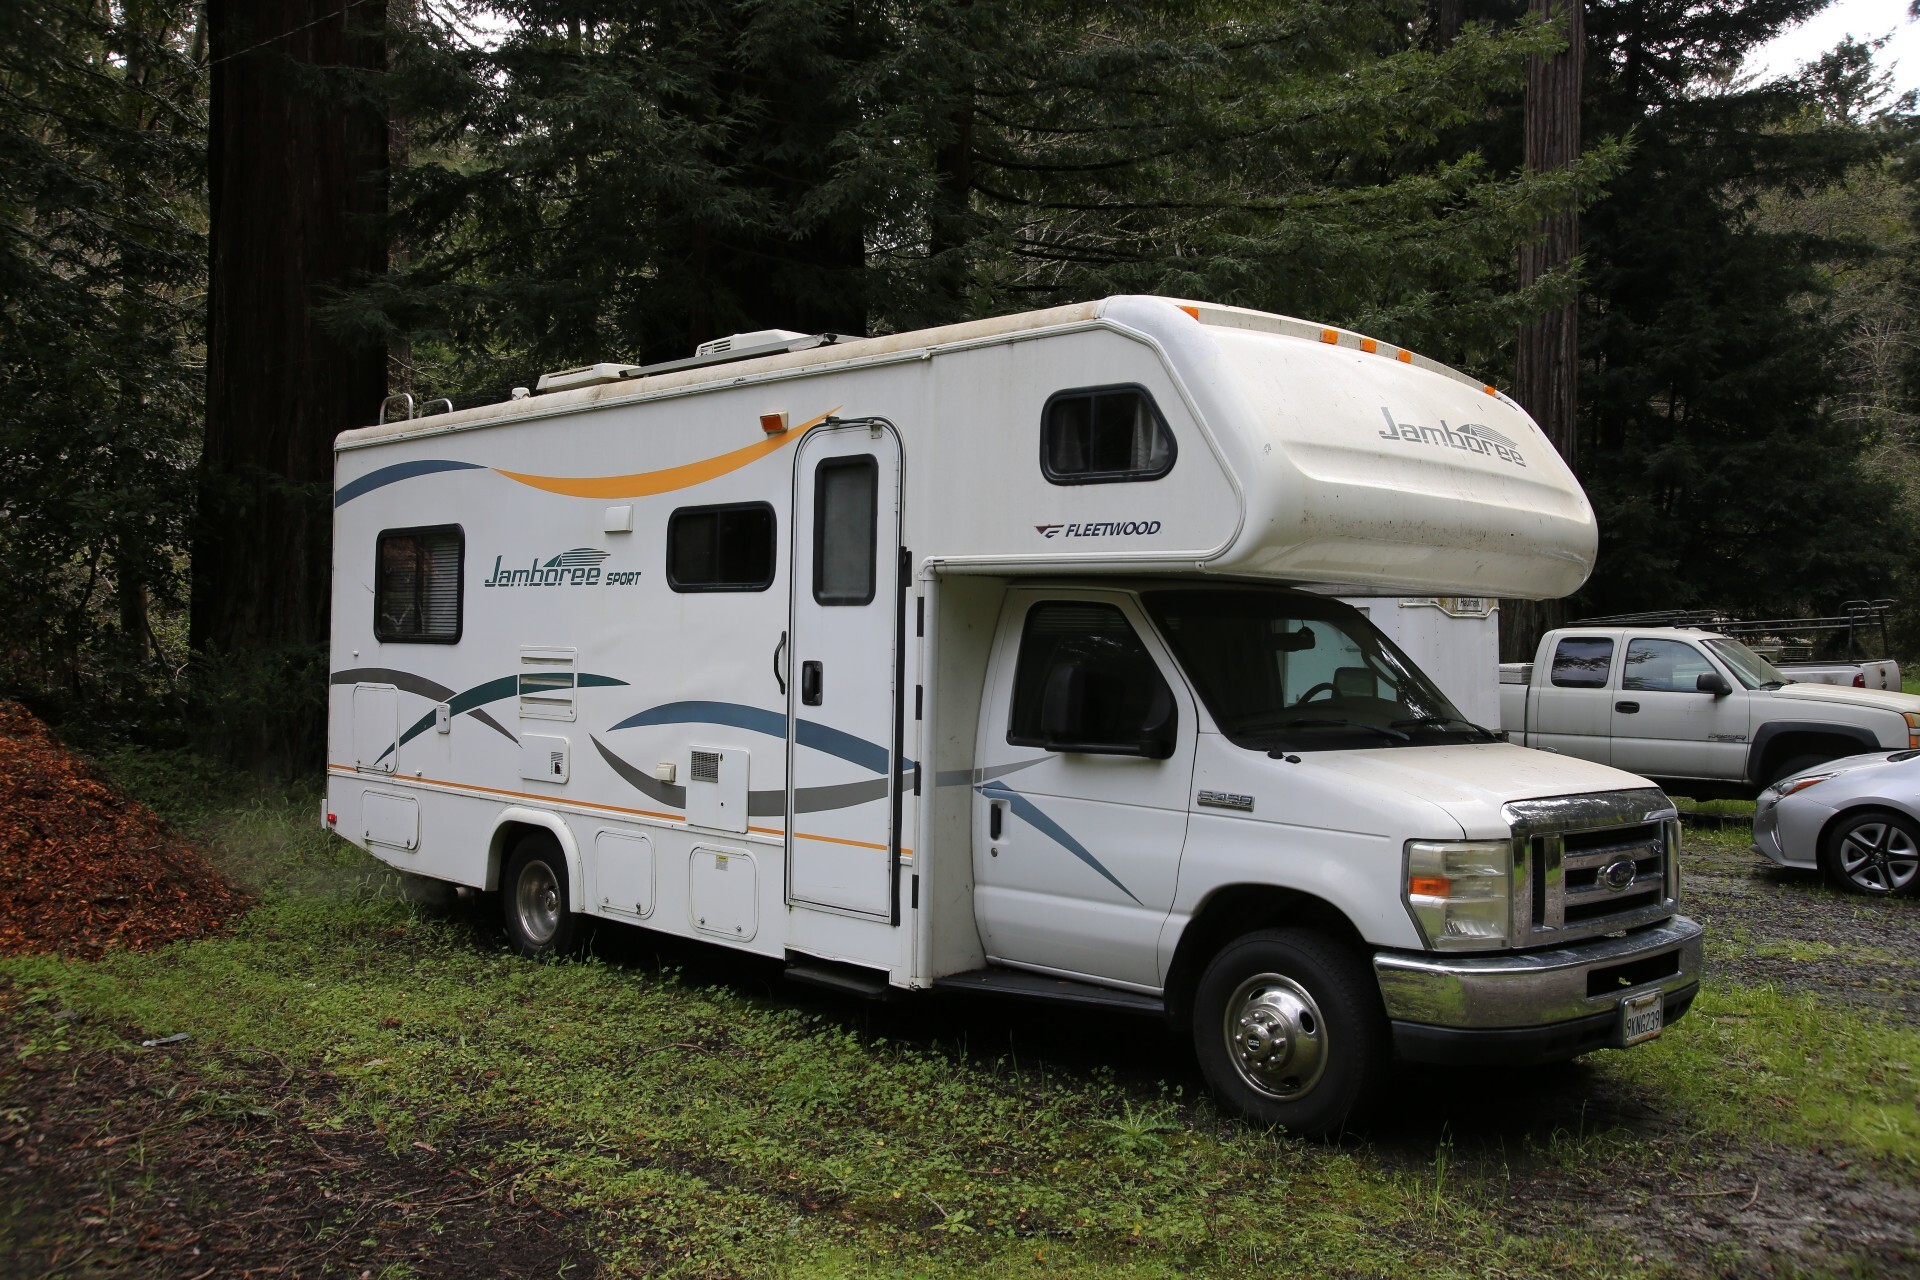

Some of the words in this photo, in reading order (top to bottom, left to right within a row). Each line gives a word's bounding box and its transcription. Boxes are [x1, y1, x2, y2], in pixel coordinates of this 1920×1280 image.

[1378, 407, 1527, 467] Jamboree
[1065, 520, 1161, 537] FLEETWOOD
[484, 555, 601, 587] Jamboree
[606, 571, 642, 586] SPORT
